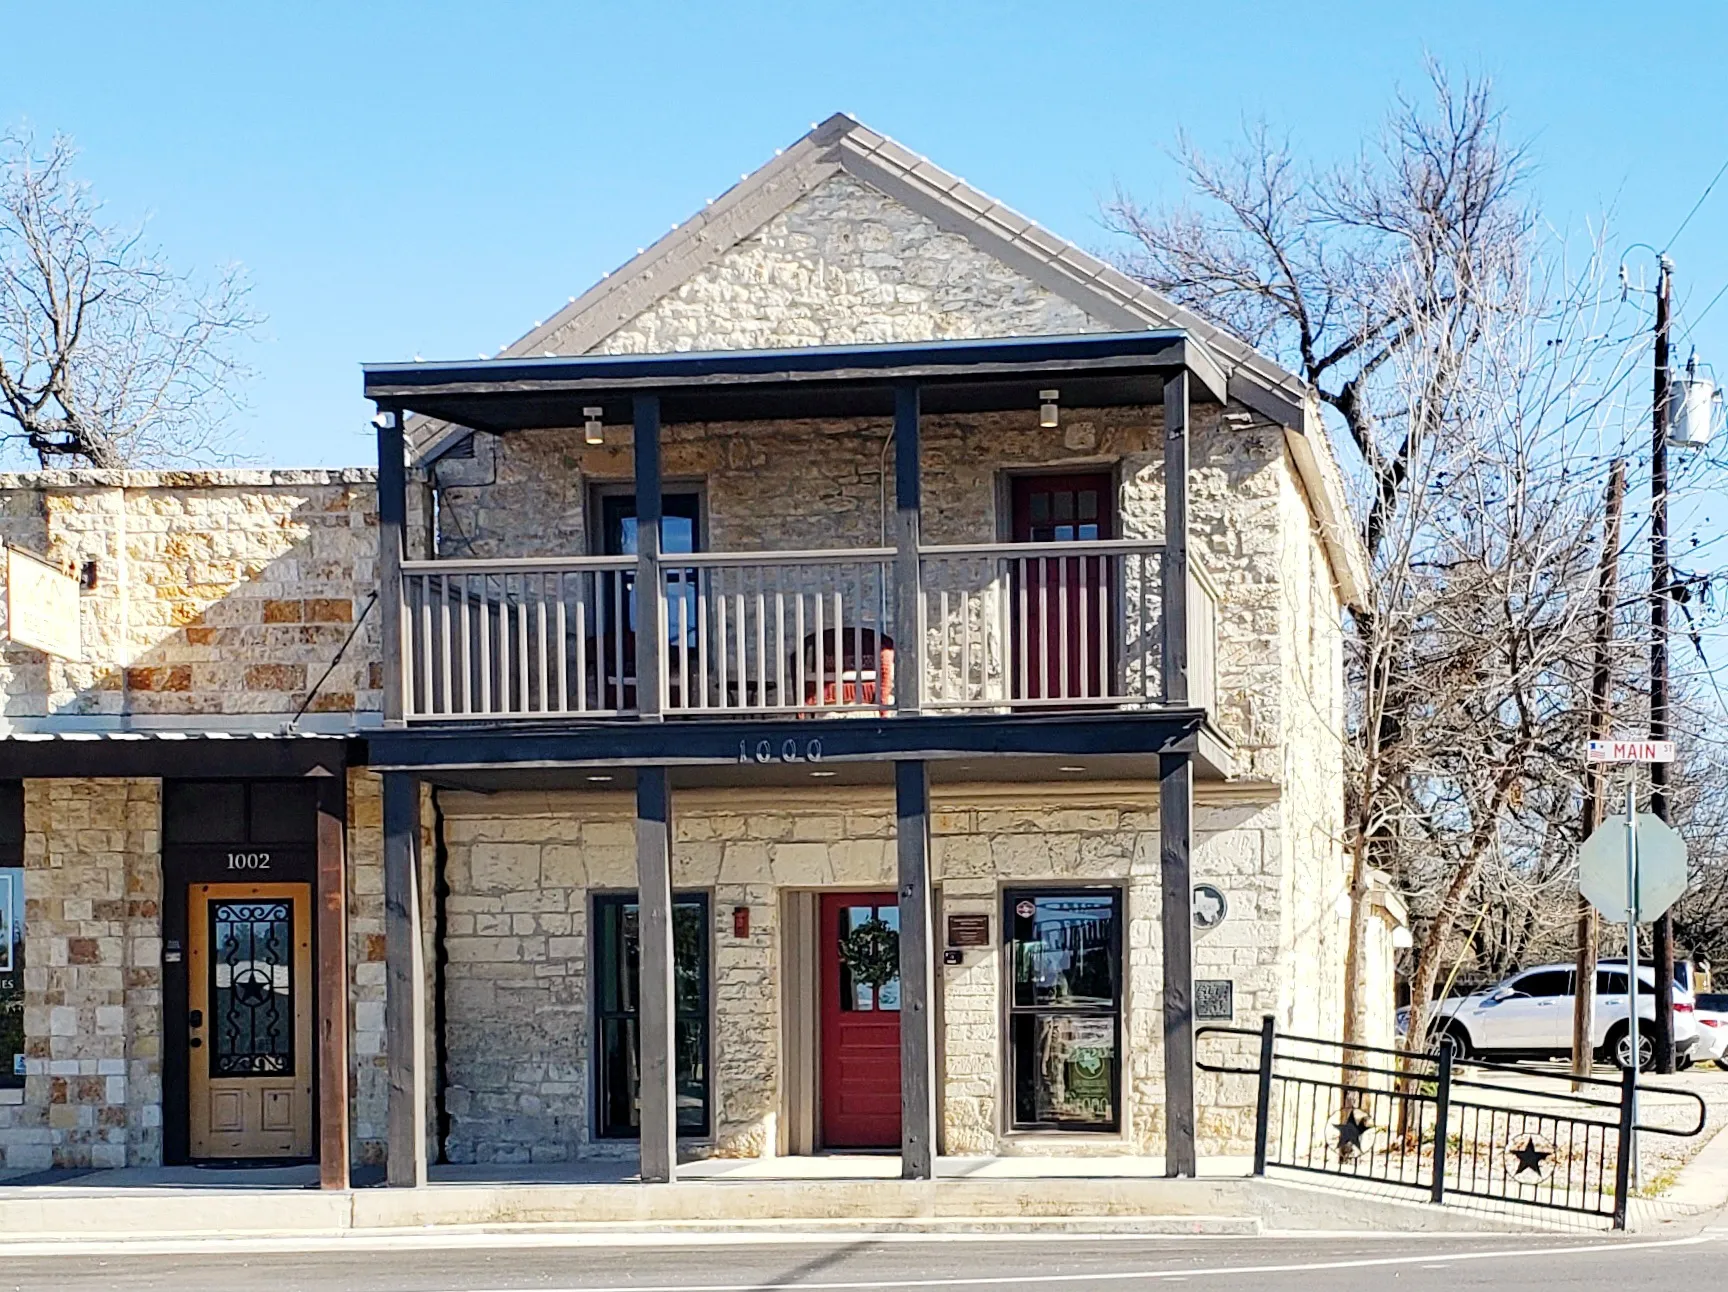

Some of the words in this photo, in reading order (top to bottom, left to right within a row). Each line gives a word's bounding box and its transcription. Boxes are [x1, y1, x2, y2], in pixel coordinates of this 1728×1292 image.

[739, 739, 822, 763] 1000
[1614, 743, 1656, 759] MAIN
[1663, 744, 1672, 752] ST
[227, 853, 271, 869] 1002
[0, 979, 14, 989] ES
